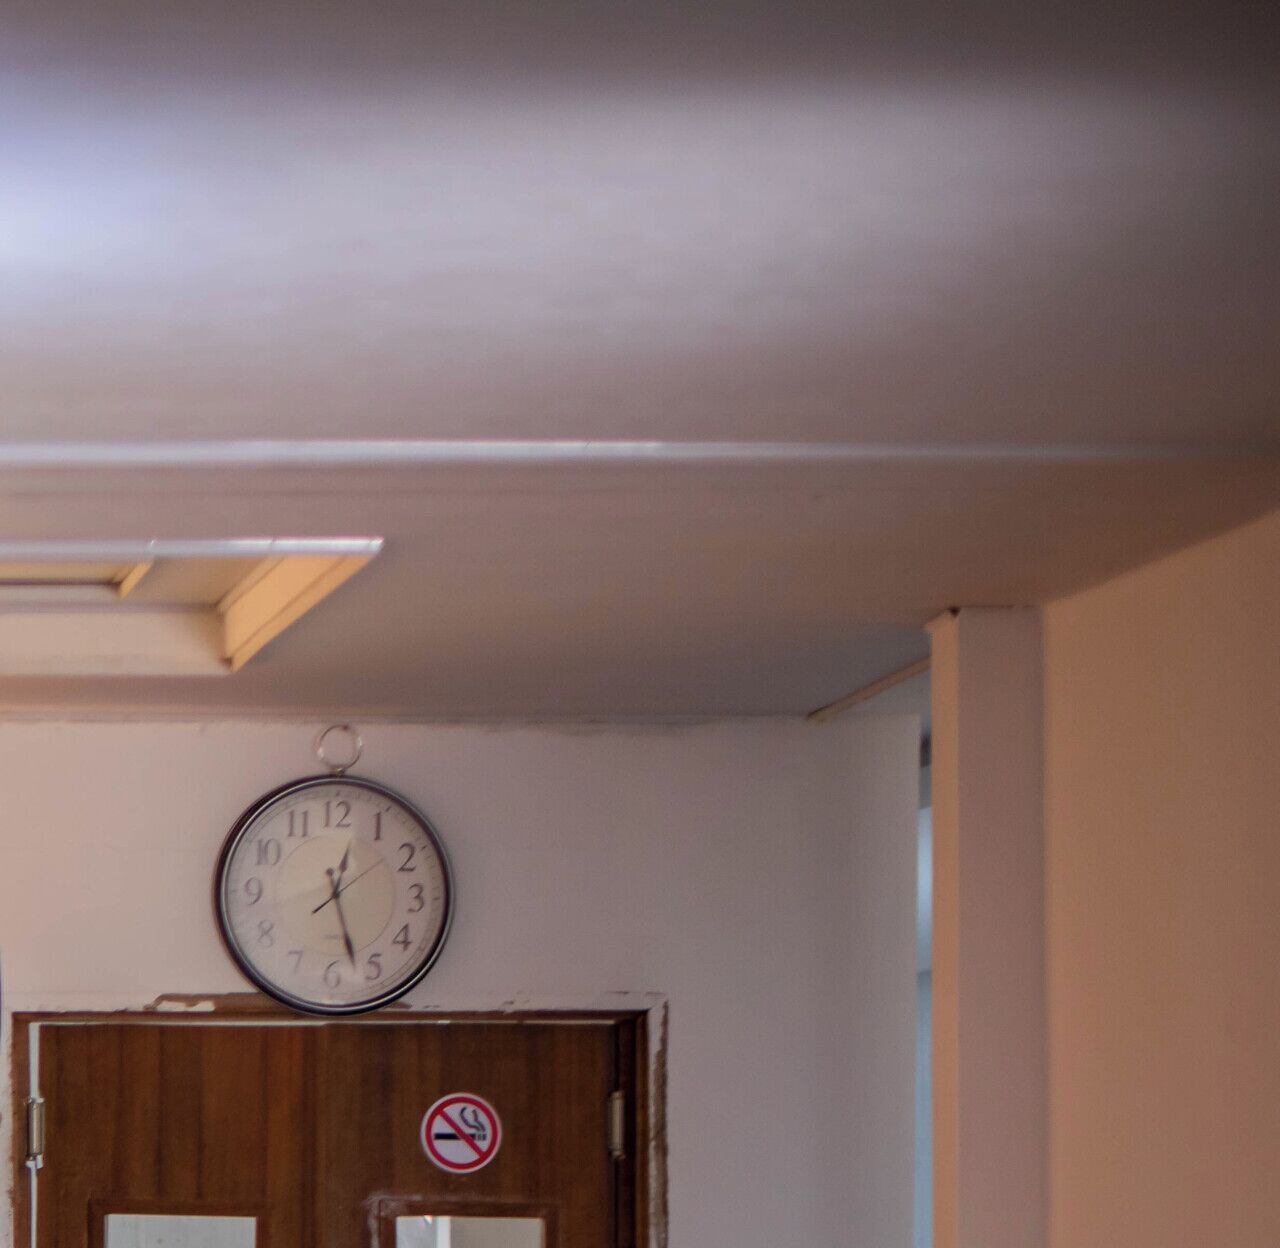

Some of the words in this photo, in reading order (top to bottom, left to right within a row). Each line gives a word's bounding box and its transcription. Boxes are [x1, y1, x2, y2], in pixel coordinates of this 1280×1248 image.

[286, 809, 309, 838] 11
[323, 800, 352, 828] 12
[374, 811, 383, 841] 1
[255, 838, 281, 866] 10
[397, 842, 416, 872] 2
[244, 877, 264, 906] 9
[406, 883, 425, 913] 3
[256, 919, 275, 949] 8
[391, 922, 412, 952] 4
[286, 950, 305, 976] 7
[323, 960, 343, 989] 6
[364, 952, 382, 981] 5
